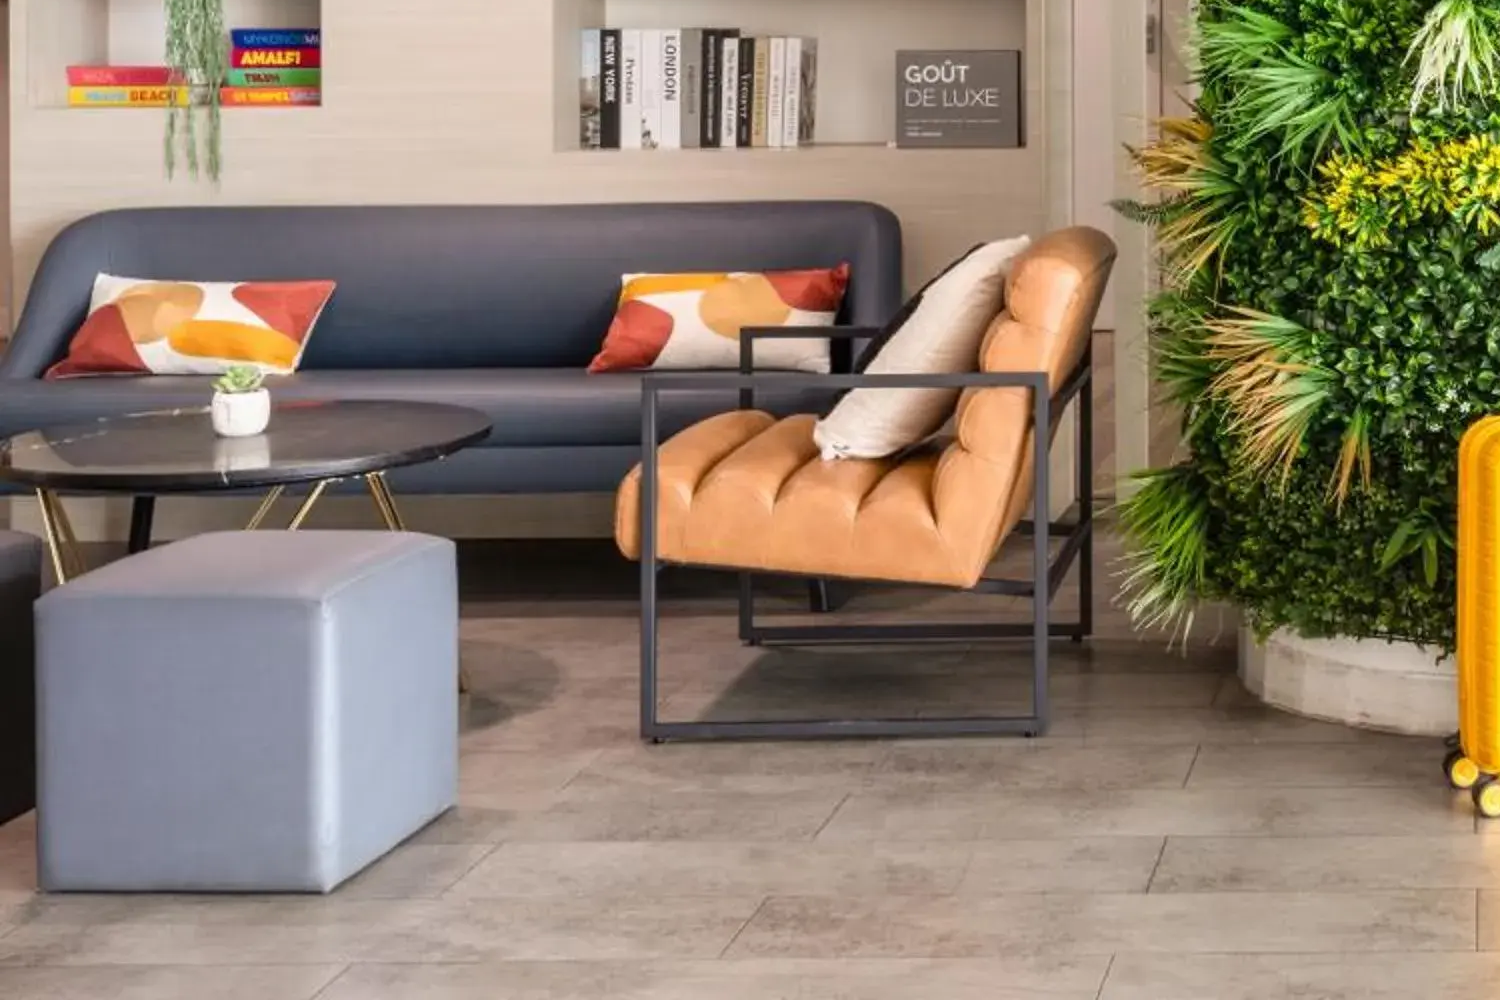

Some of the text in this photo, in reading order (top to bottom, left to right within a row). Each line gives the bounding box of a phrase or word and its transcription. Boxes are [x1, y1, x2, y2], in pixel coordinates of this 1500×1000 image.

[240, 50, 301, 66] AMALFI
[604, 35, 616, 104] NEW YORK
[663, 34, 677, 102] LONDON
[904, 60, 970, 83] GOÛT
[904, 87, 1000, 107] DE LUXE
